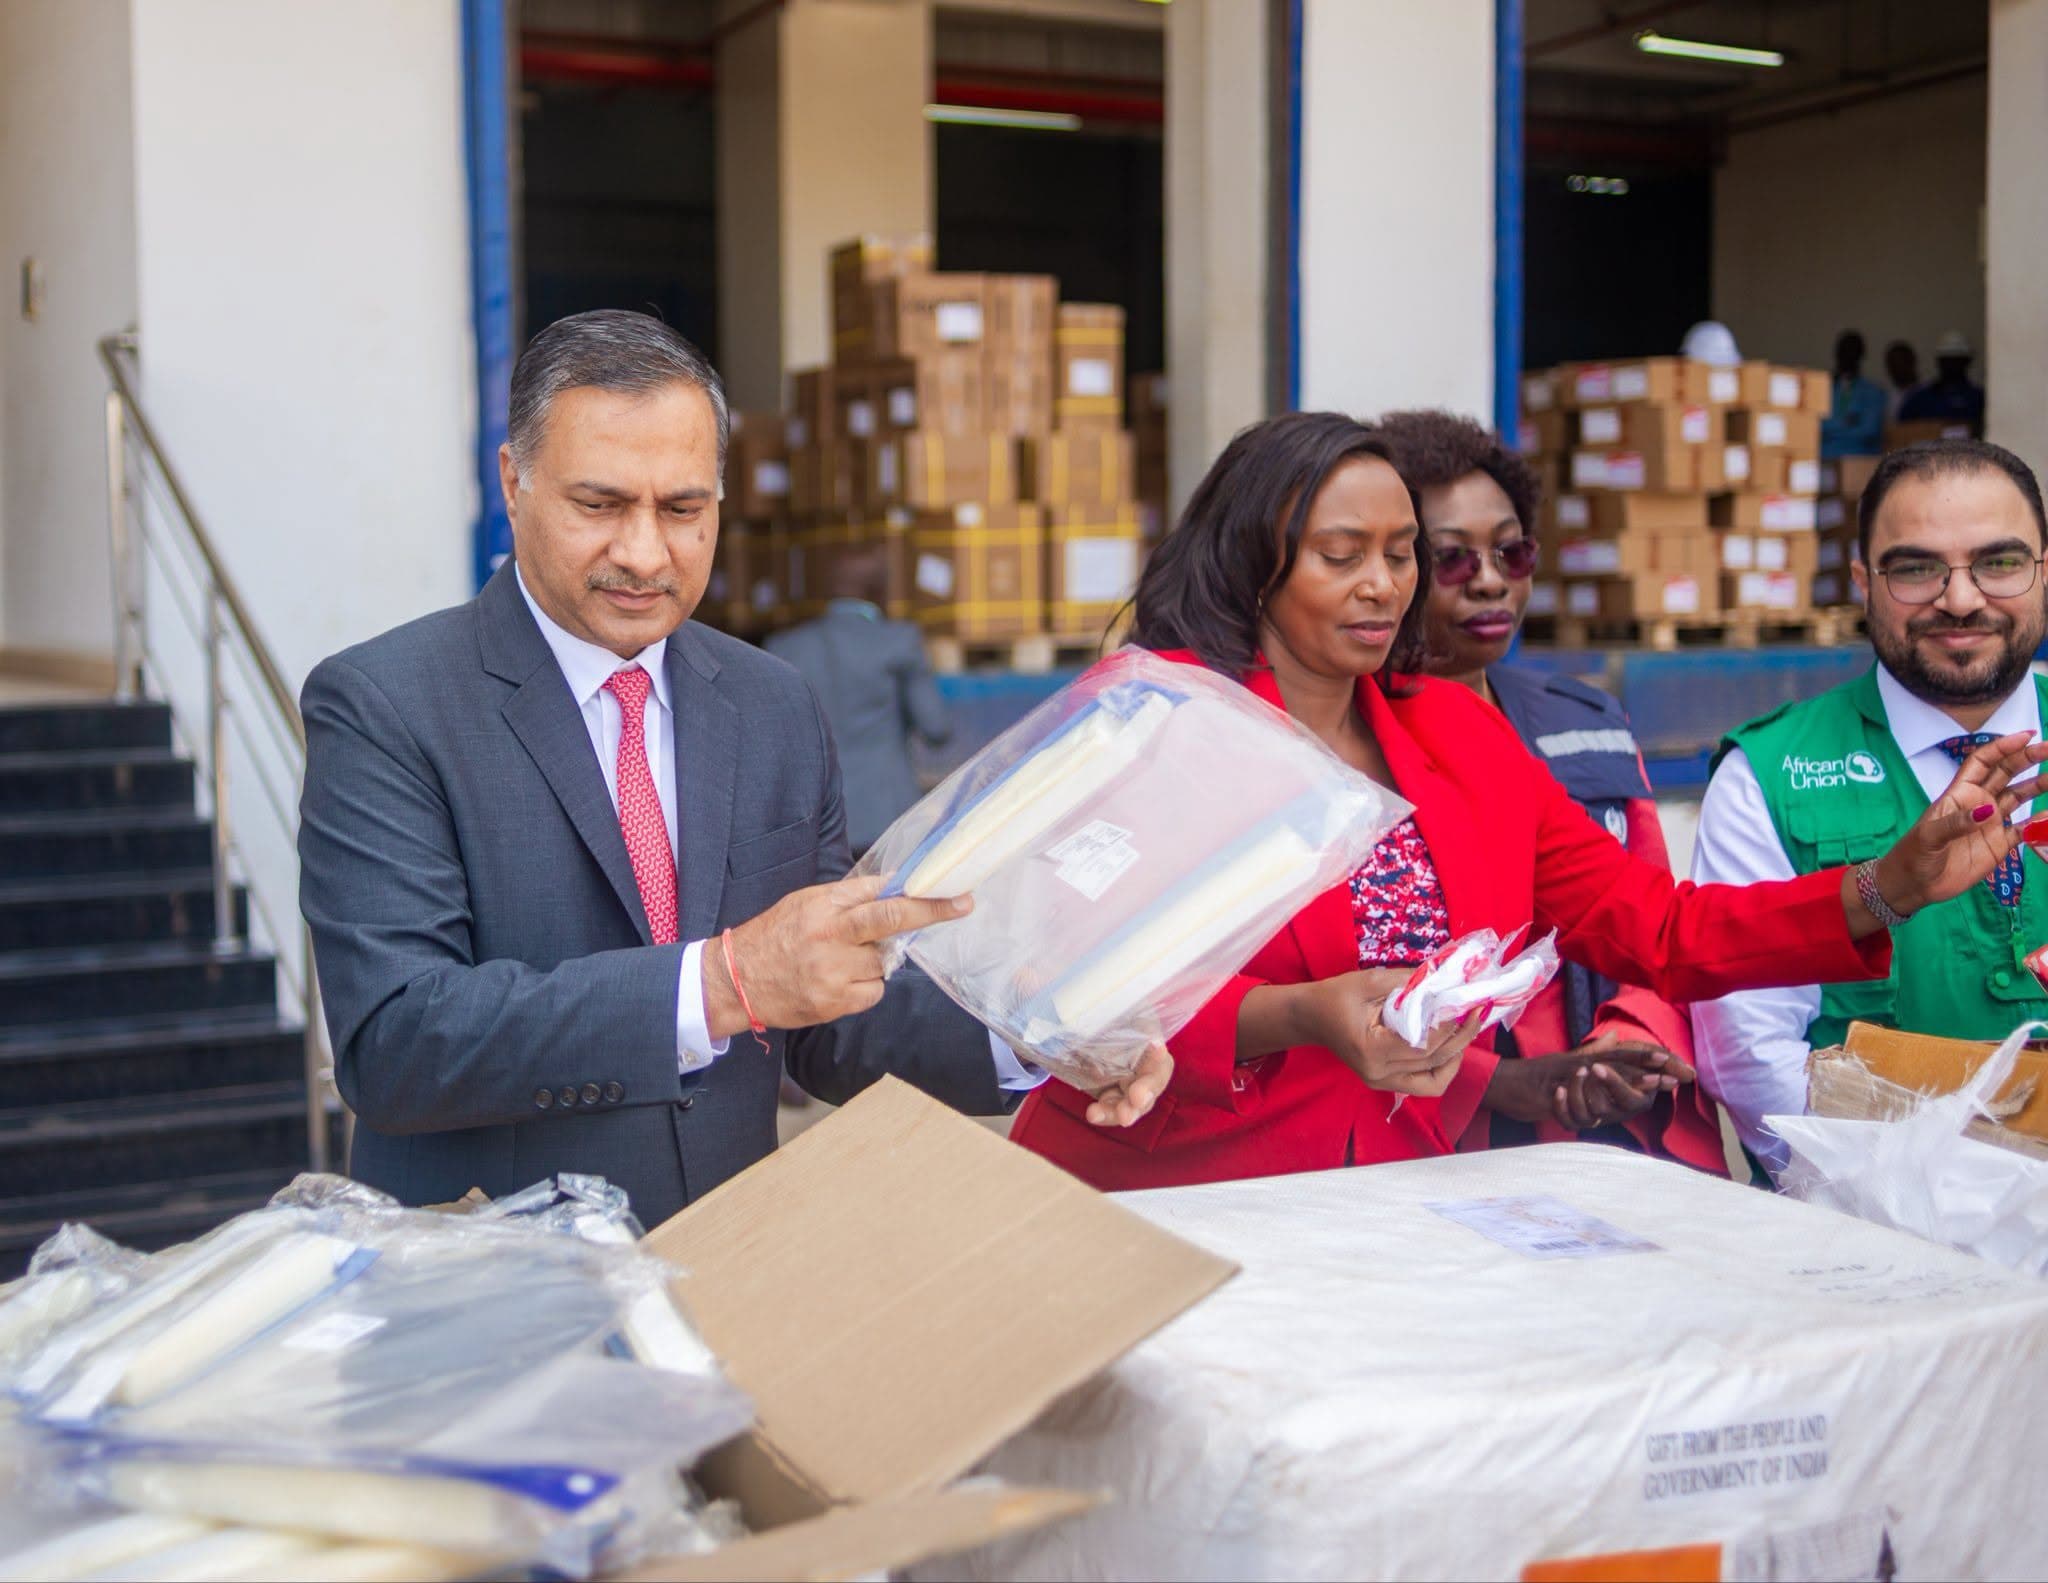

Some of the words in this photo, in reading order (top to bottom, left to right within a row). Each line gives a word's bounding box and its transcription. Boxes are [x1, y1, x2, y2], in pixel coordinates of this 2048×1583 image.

[1782, 754, 1844, 774] African
[1791, 771, 1846, 790] Union
[1646, 1432, 1679, 1463] GIFT
[1681, 1428, 1718, 1457] FROM
[1722, 1424, 1748, 1451] THE
[1751, 1418, 1795, 1449] PEOPLE
[1798, 1414, 1826, 1443] AND
[1644, 1459, 1758, 1500] GOVERNMENT
[1761, 1454, 1783, 1485] OF
[1785, 1450, 1829, 1482] INDIA
